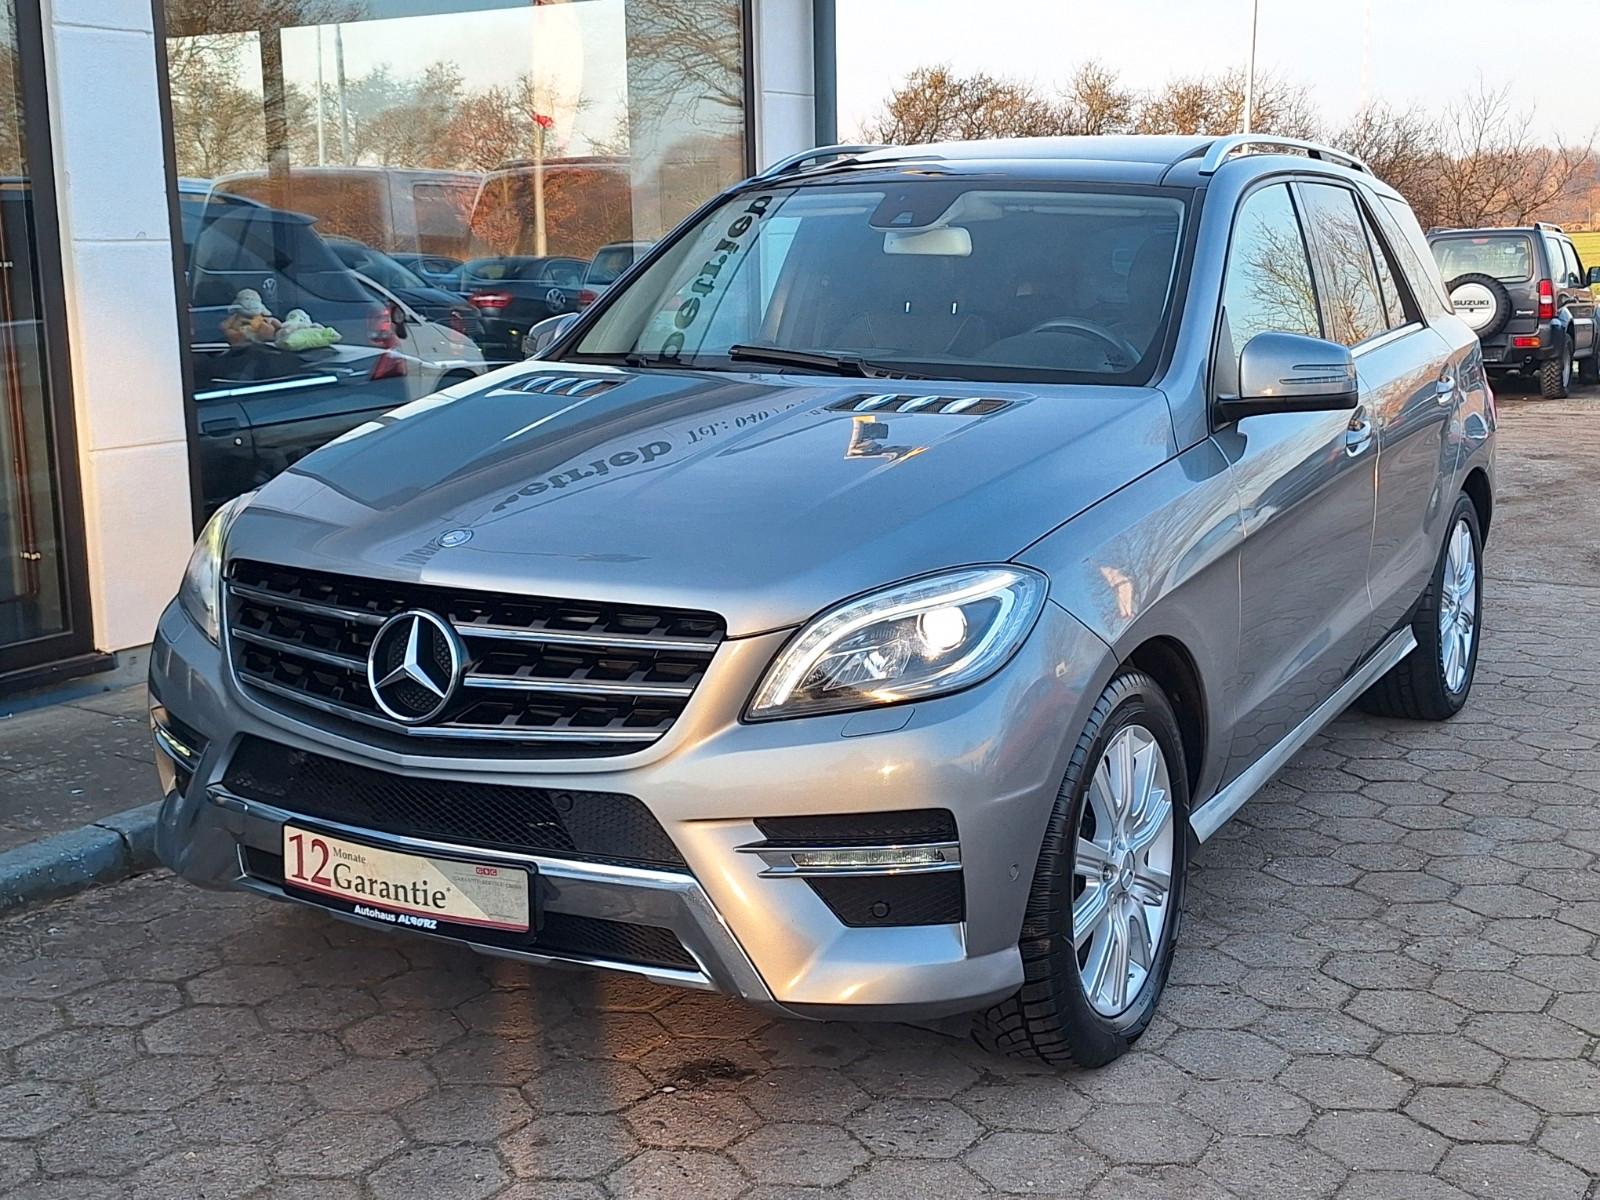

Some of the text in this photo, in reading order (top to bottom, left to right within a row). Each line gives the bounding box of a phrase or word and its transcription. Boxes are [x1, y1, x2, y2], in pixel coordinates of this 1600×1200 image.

[288, 833, 366, 887] 12 Monate
[353, 904, 396, 922] Autohaus
